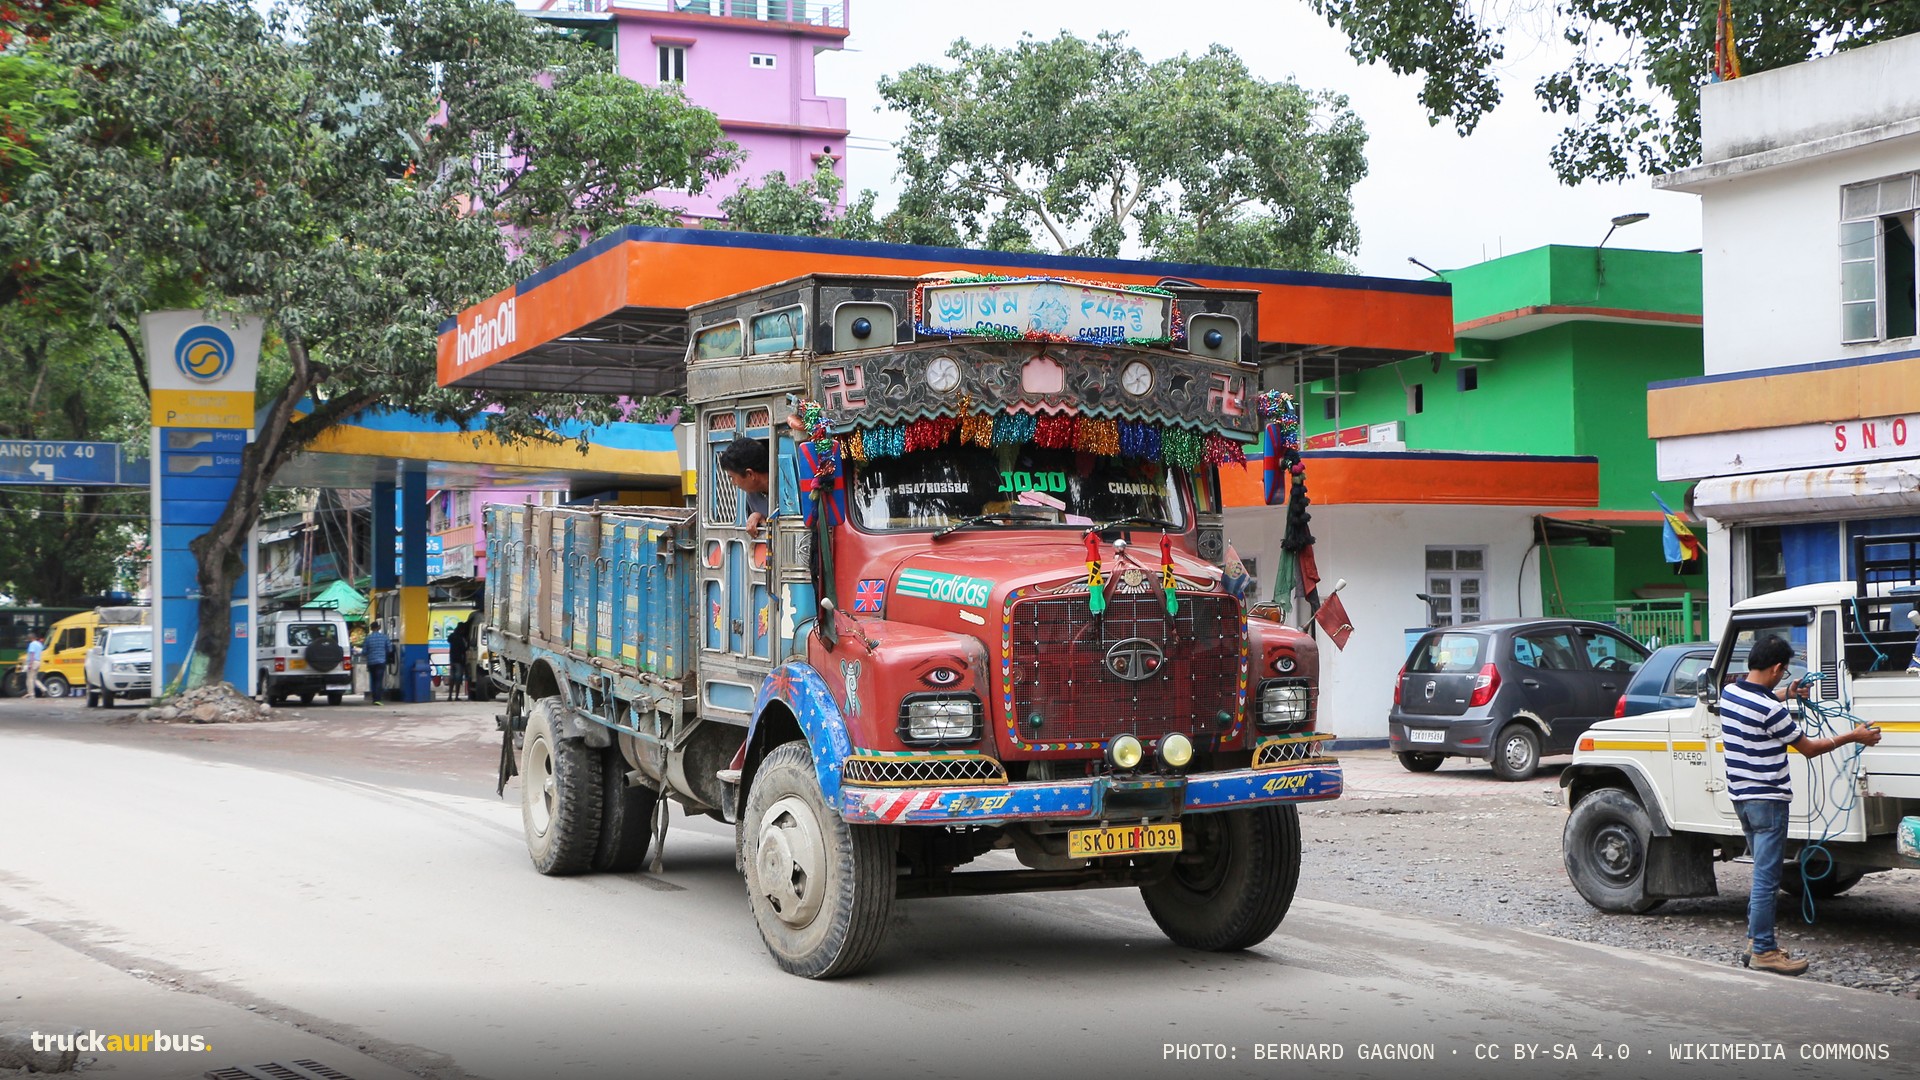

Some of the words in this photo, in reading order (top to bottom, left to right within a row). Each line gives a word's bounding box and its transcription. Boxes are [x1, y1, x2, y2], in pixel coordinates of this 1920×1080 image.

[457, 297, 516, 366] IndianOil
[1079, 325, 1125, 339] CARRIER
[215, 431, 242, 442] Petrol
[73, 445, 95, 458] 40
[998, 471, 1067, 493] JOJO
[930, 575, 988, 607] adidas
[1673, 752, 1703, 761] BOLERO
[1262, 774, 1308, 791] 40KM
[948, 794, 1010, 812] SPEED
